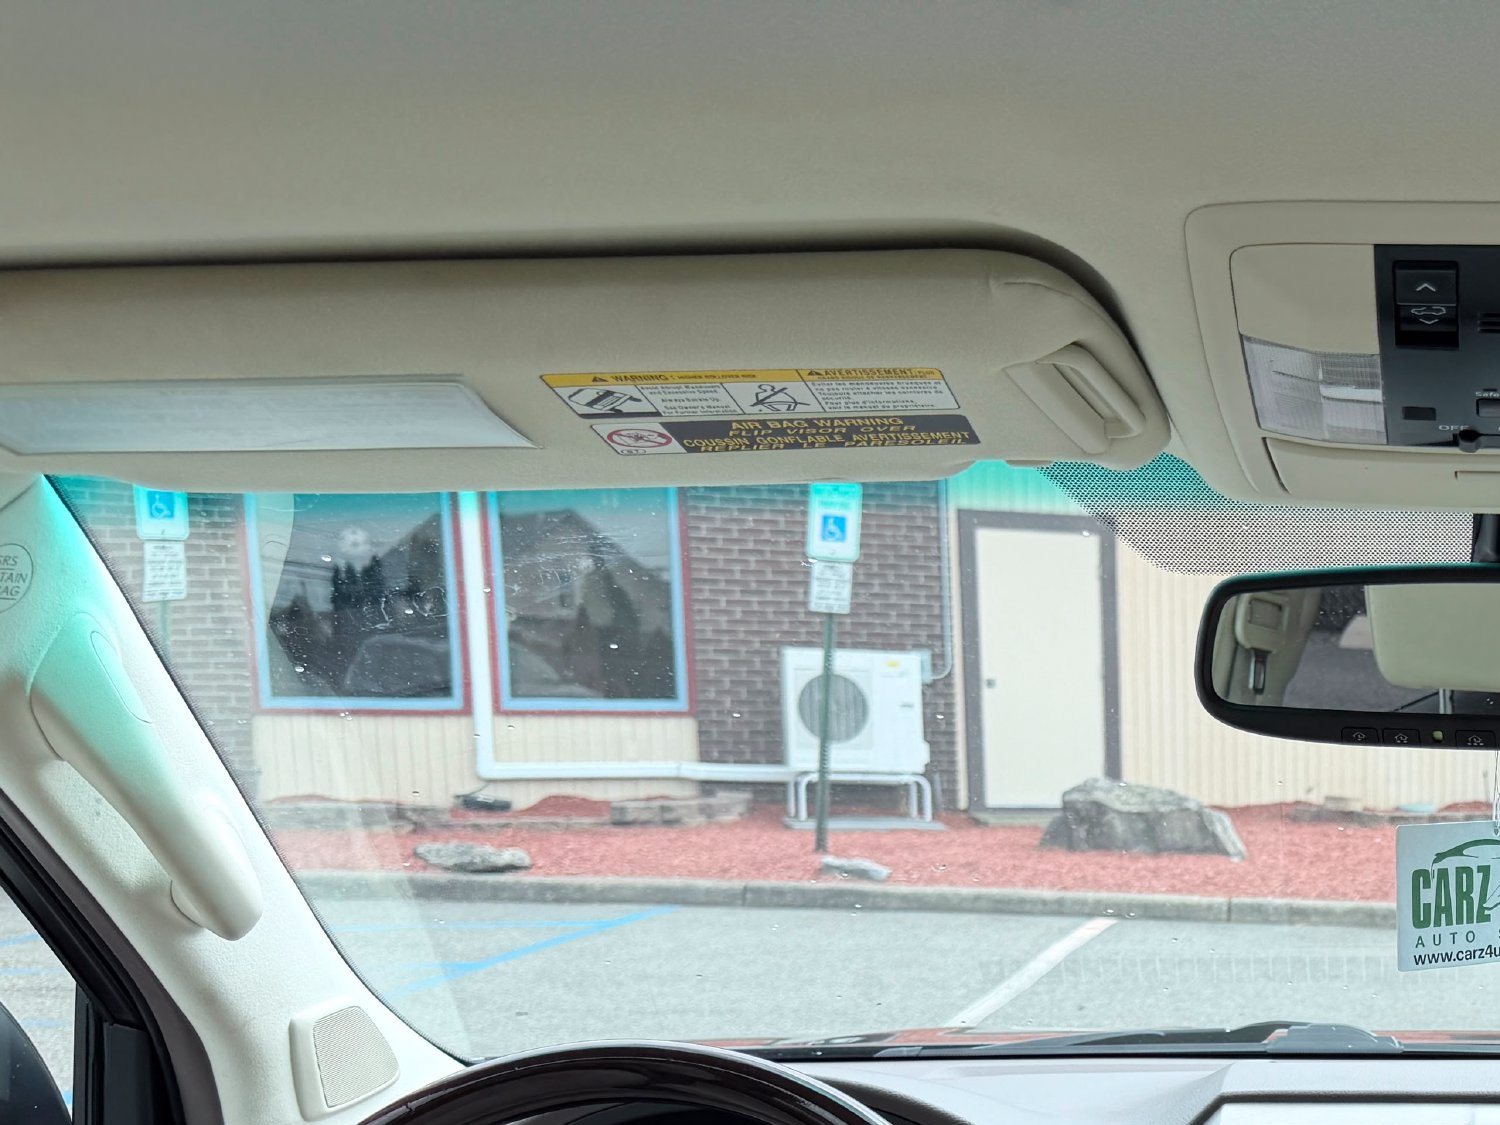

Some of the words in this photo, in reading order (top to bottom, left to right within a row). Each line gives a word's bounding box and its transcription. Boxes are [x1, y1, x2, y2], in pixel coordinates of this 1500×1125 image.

[730, 421, 764, 431] AIR
[767, 419, 809, 429] BAG
[814, 417, 904, 427] WARNING
[786, 427, 847, 435] VISOR
[860, 425, 916, 433] OVER
[683, 438, 750, 448] COUSSIN
[852, 431, 971, 441] AVERTISSEMENT
[844, 438, 967, 448] PARESOLEIL
[1415, 930, 1476, 949] AUTO
